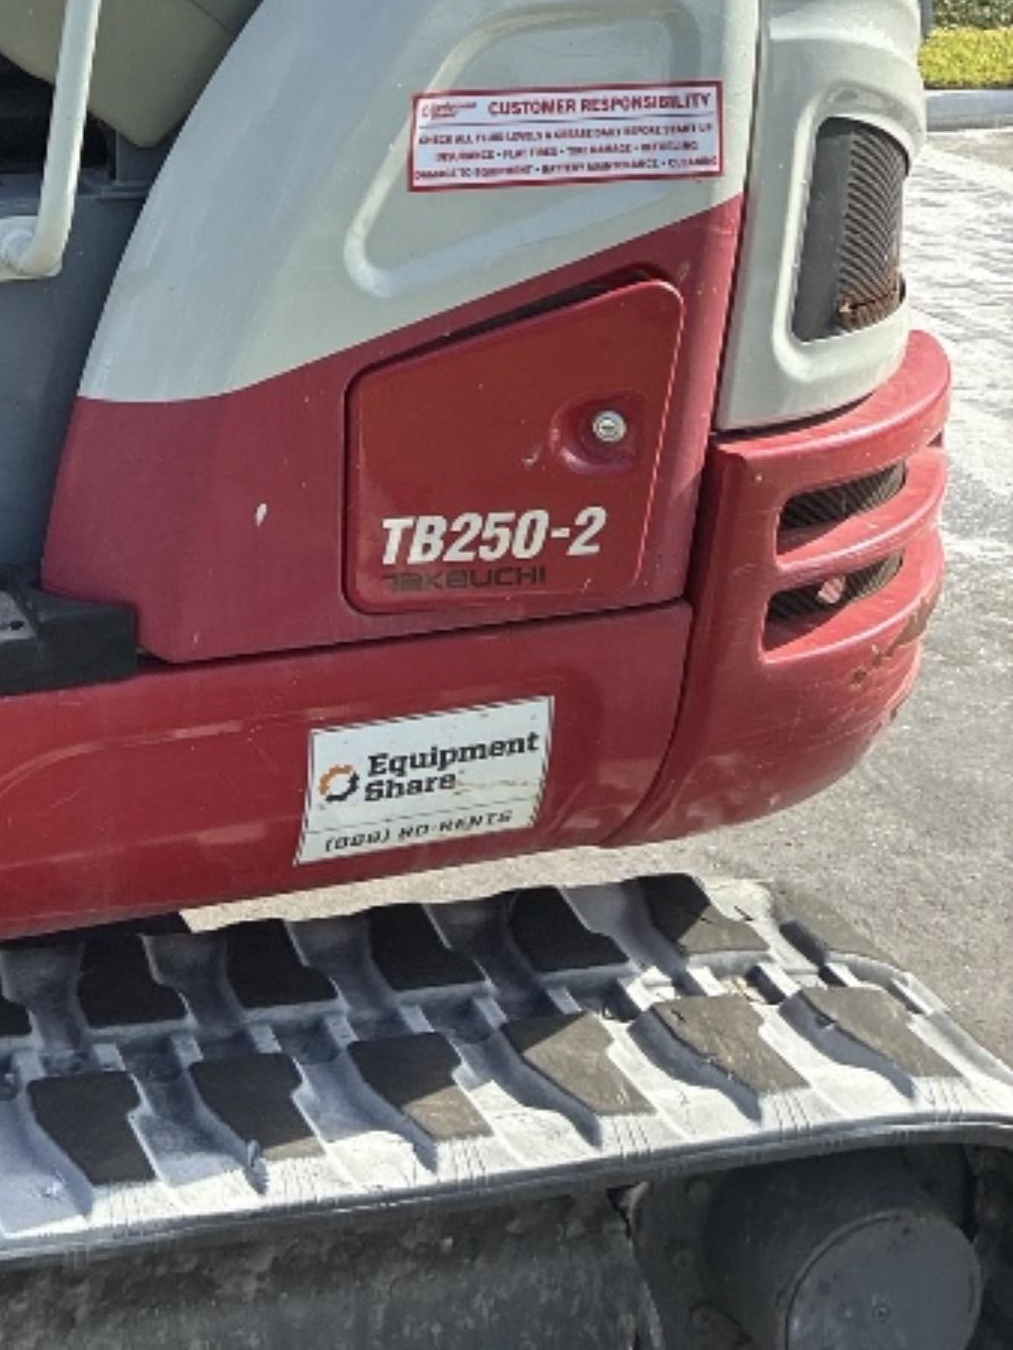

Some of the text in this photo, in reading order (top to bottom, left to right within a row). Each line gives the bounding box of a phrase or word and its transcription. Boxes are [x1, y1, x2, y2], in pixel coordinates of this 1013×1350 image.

[488, 99, 576, 116] CUSTOMER
[580, 92, 711, 114] RESPONSIBILITY
[381, 506, 607, 565] TB250-2
[368, 731, 540, 777] Equipment
[364, 772, 457, 802] Share
